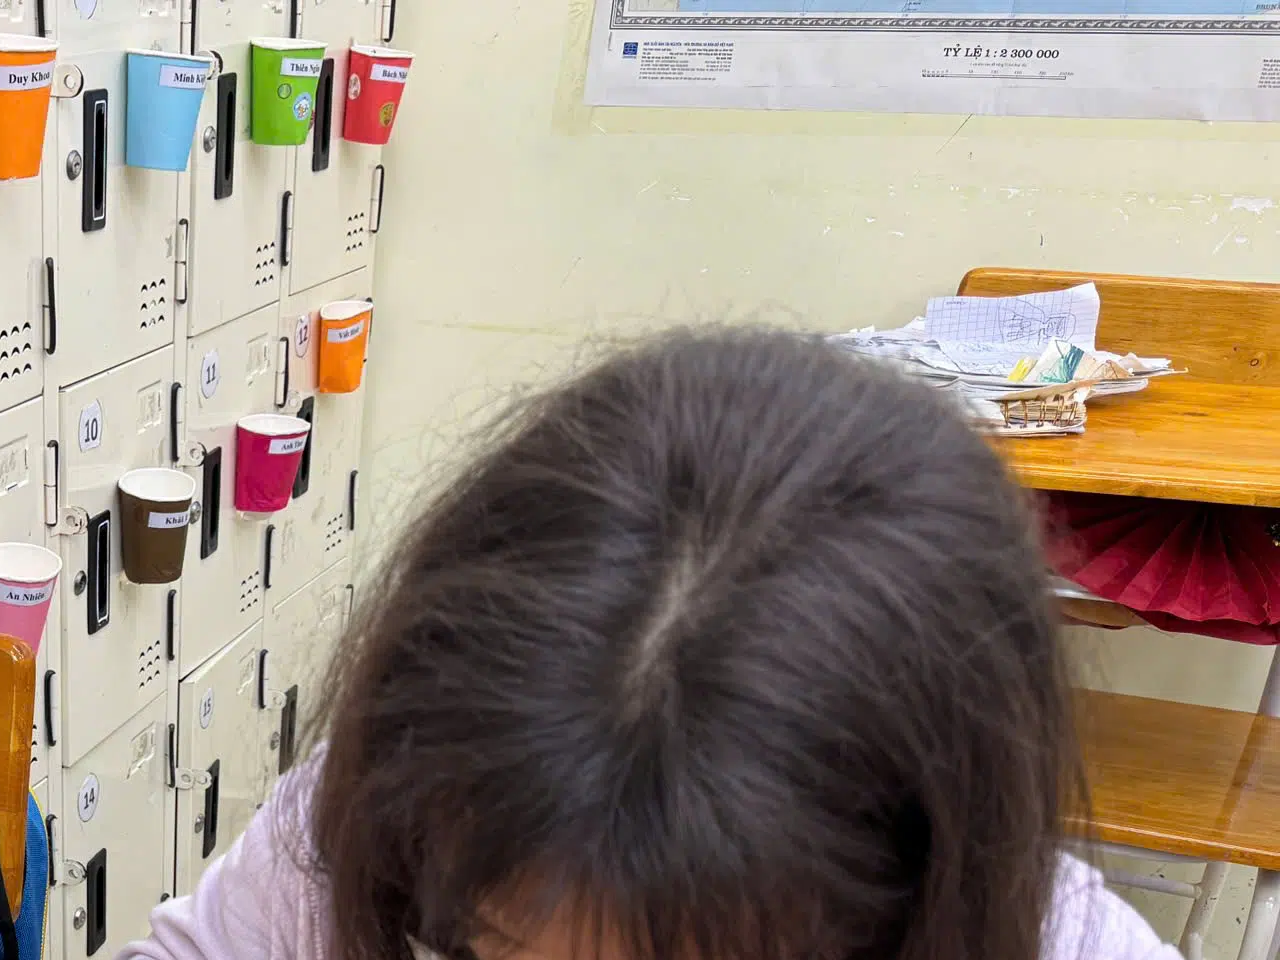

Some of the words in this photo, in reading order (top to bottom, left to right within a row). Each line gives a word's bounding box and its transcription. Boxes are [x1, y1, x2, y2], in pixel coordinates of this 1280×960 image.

[964, 45, 983, 60] LỆ
[984, 49, 990, 58] 1
[999, 49, 1008, 58] 2
[1010, 49, 1033, 59] 300
[1036, 49, 1060, 59] 000
[9, 73, 29, 86] Duy
[173, 72, 195, 84] Minh
[298, 325, 308, 345] 12
[206, 364, 216, 385] 11
[84, 417, 98, 443] 10
[6, 591, 20, 601] An
[83, 787, 95, 810] 14
